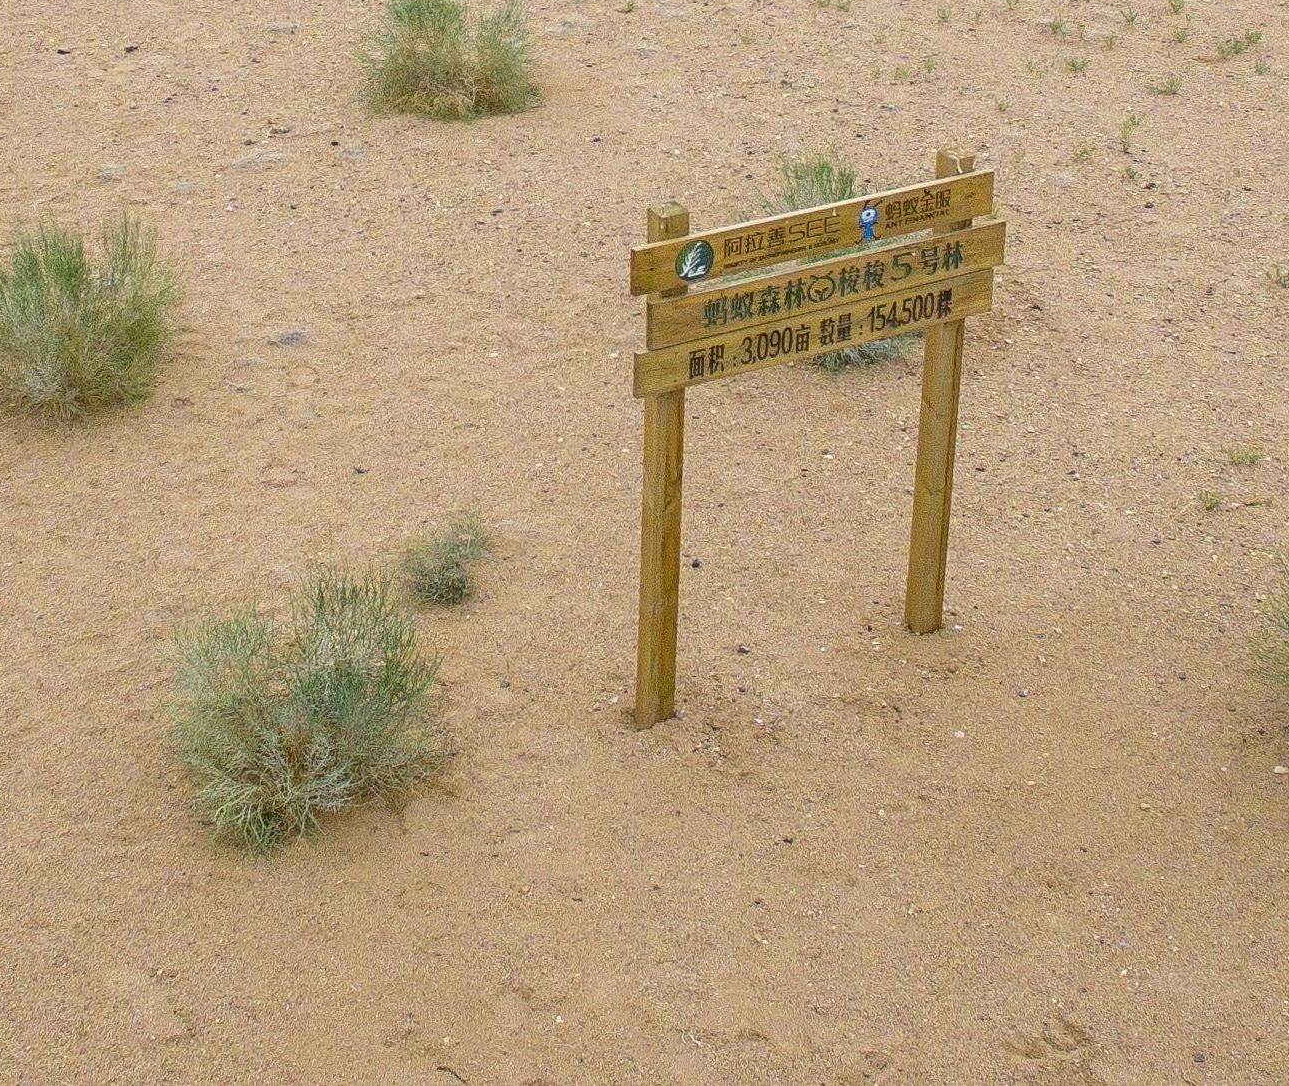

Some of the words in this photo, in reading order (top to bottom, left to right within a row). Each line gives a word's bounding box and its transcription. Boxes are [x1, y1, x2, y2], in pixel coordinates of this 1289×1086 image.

[885, 189, 951, 220] 蚂蚁金服
[724, 215, 840, 258] 阿拉善SEE
